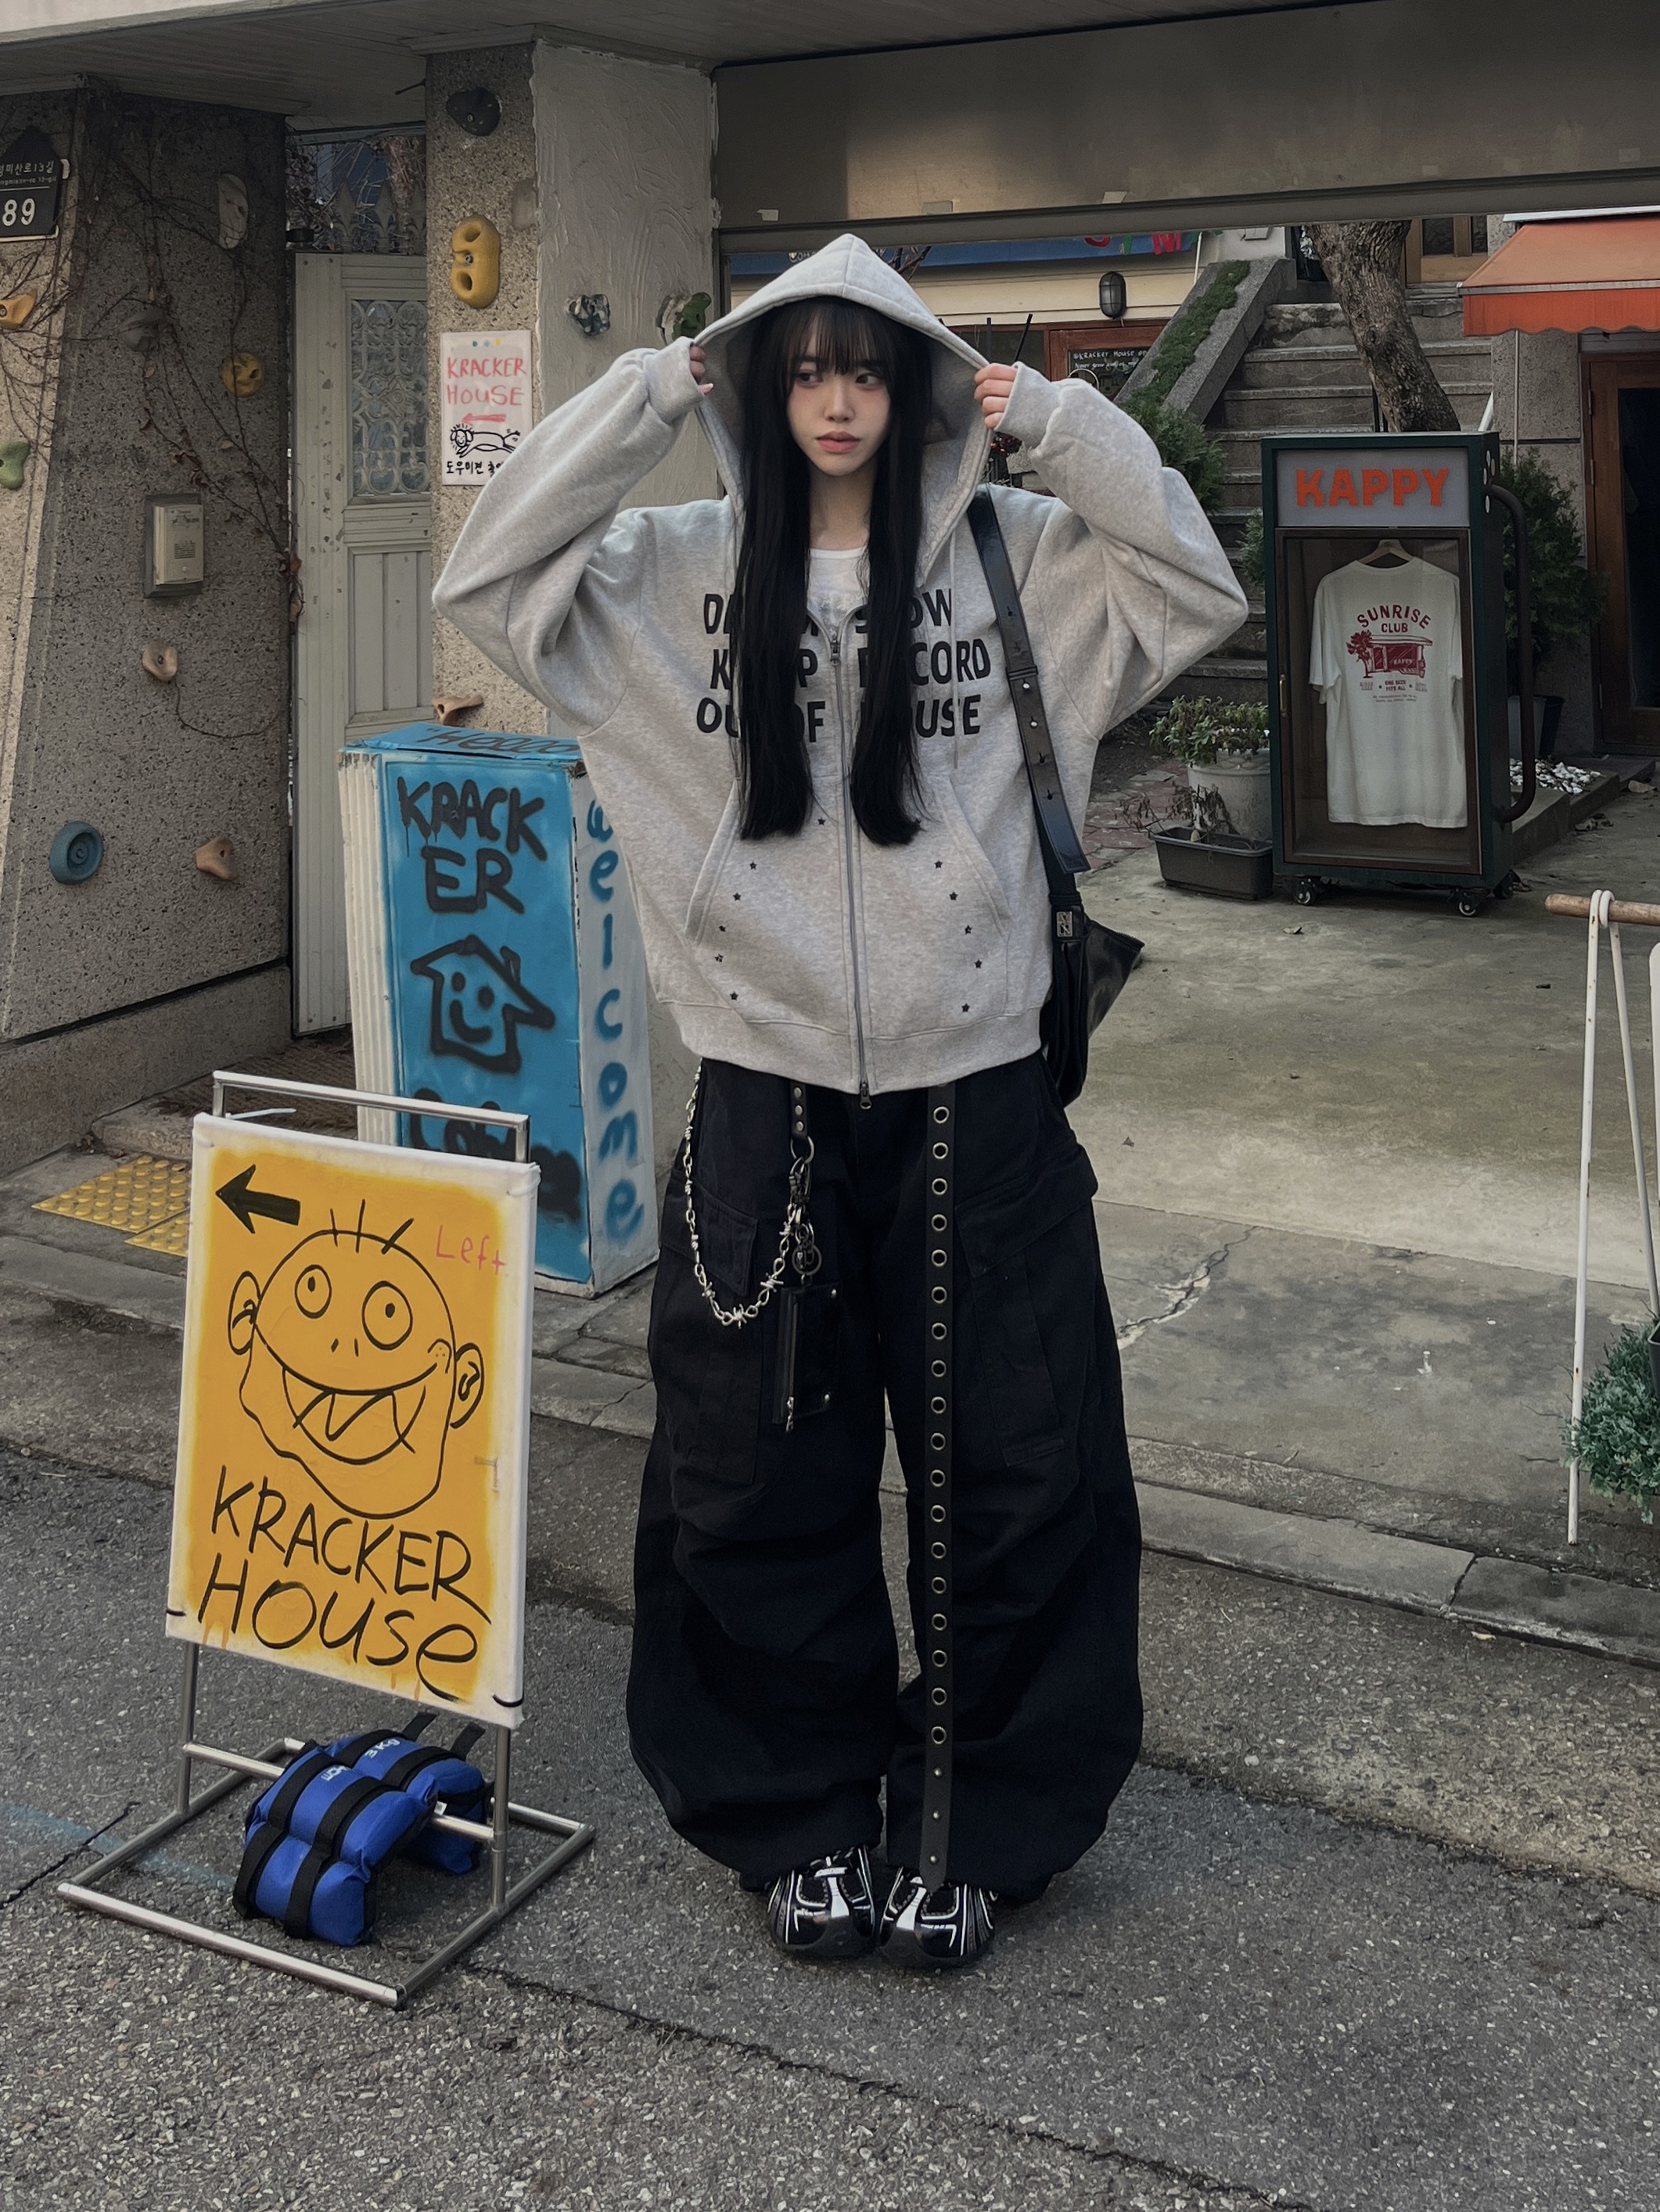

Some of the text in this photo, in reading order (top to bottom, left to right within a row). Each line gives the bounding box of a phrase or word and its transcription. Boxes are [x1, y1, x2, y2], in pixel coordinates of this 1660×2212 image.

[2, 198, 35, 226] 89
[447, 356, 526, 379] KRACKER
[1295, 469, 1450, 507] KAPPY
[1357, 605, 1432, 629] SUNRISE
[1382, 623, 1408, 633] CLUB
[397, 776, 548, 862] KRACK
[421, 845, 526, 915] ER
[434, 1224, 506, 1275] Left
[211, 1464, 491, 1625] KRACKER
